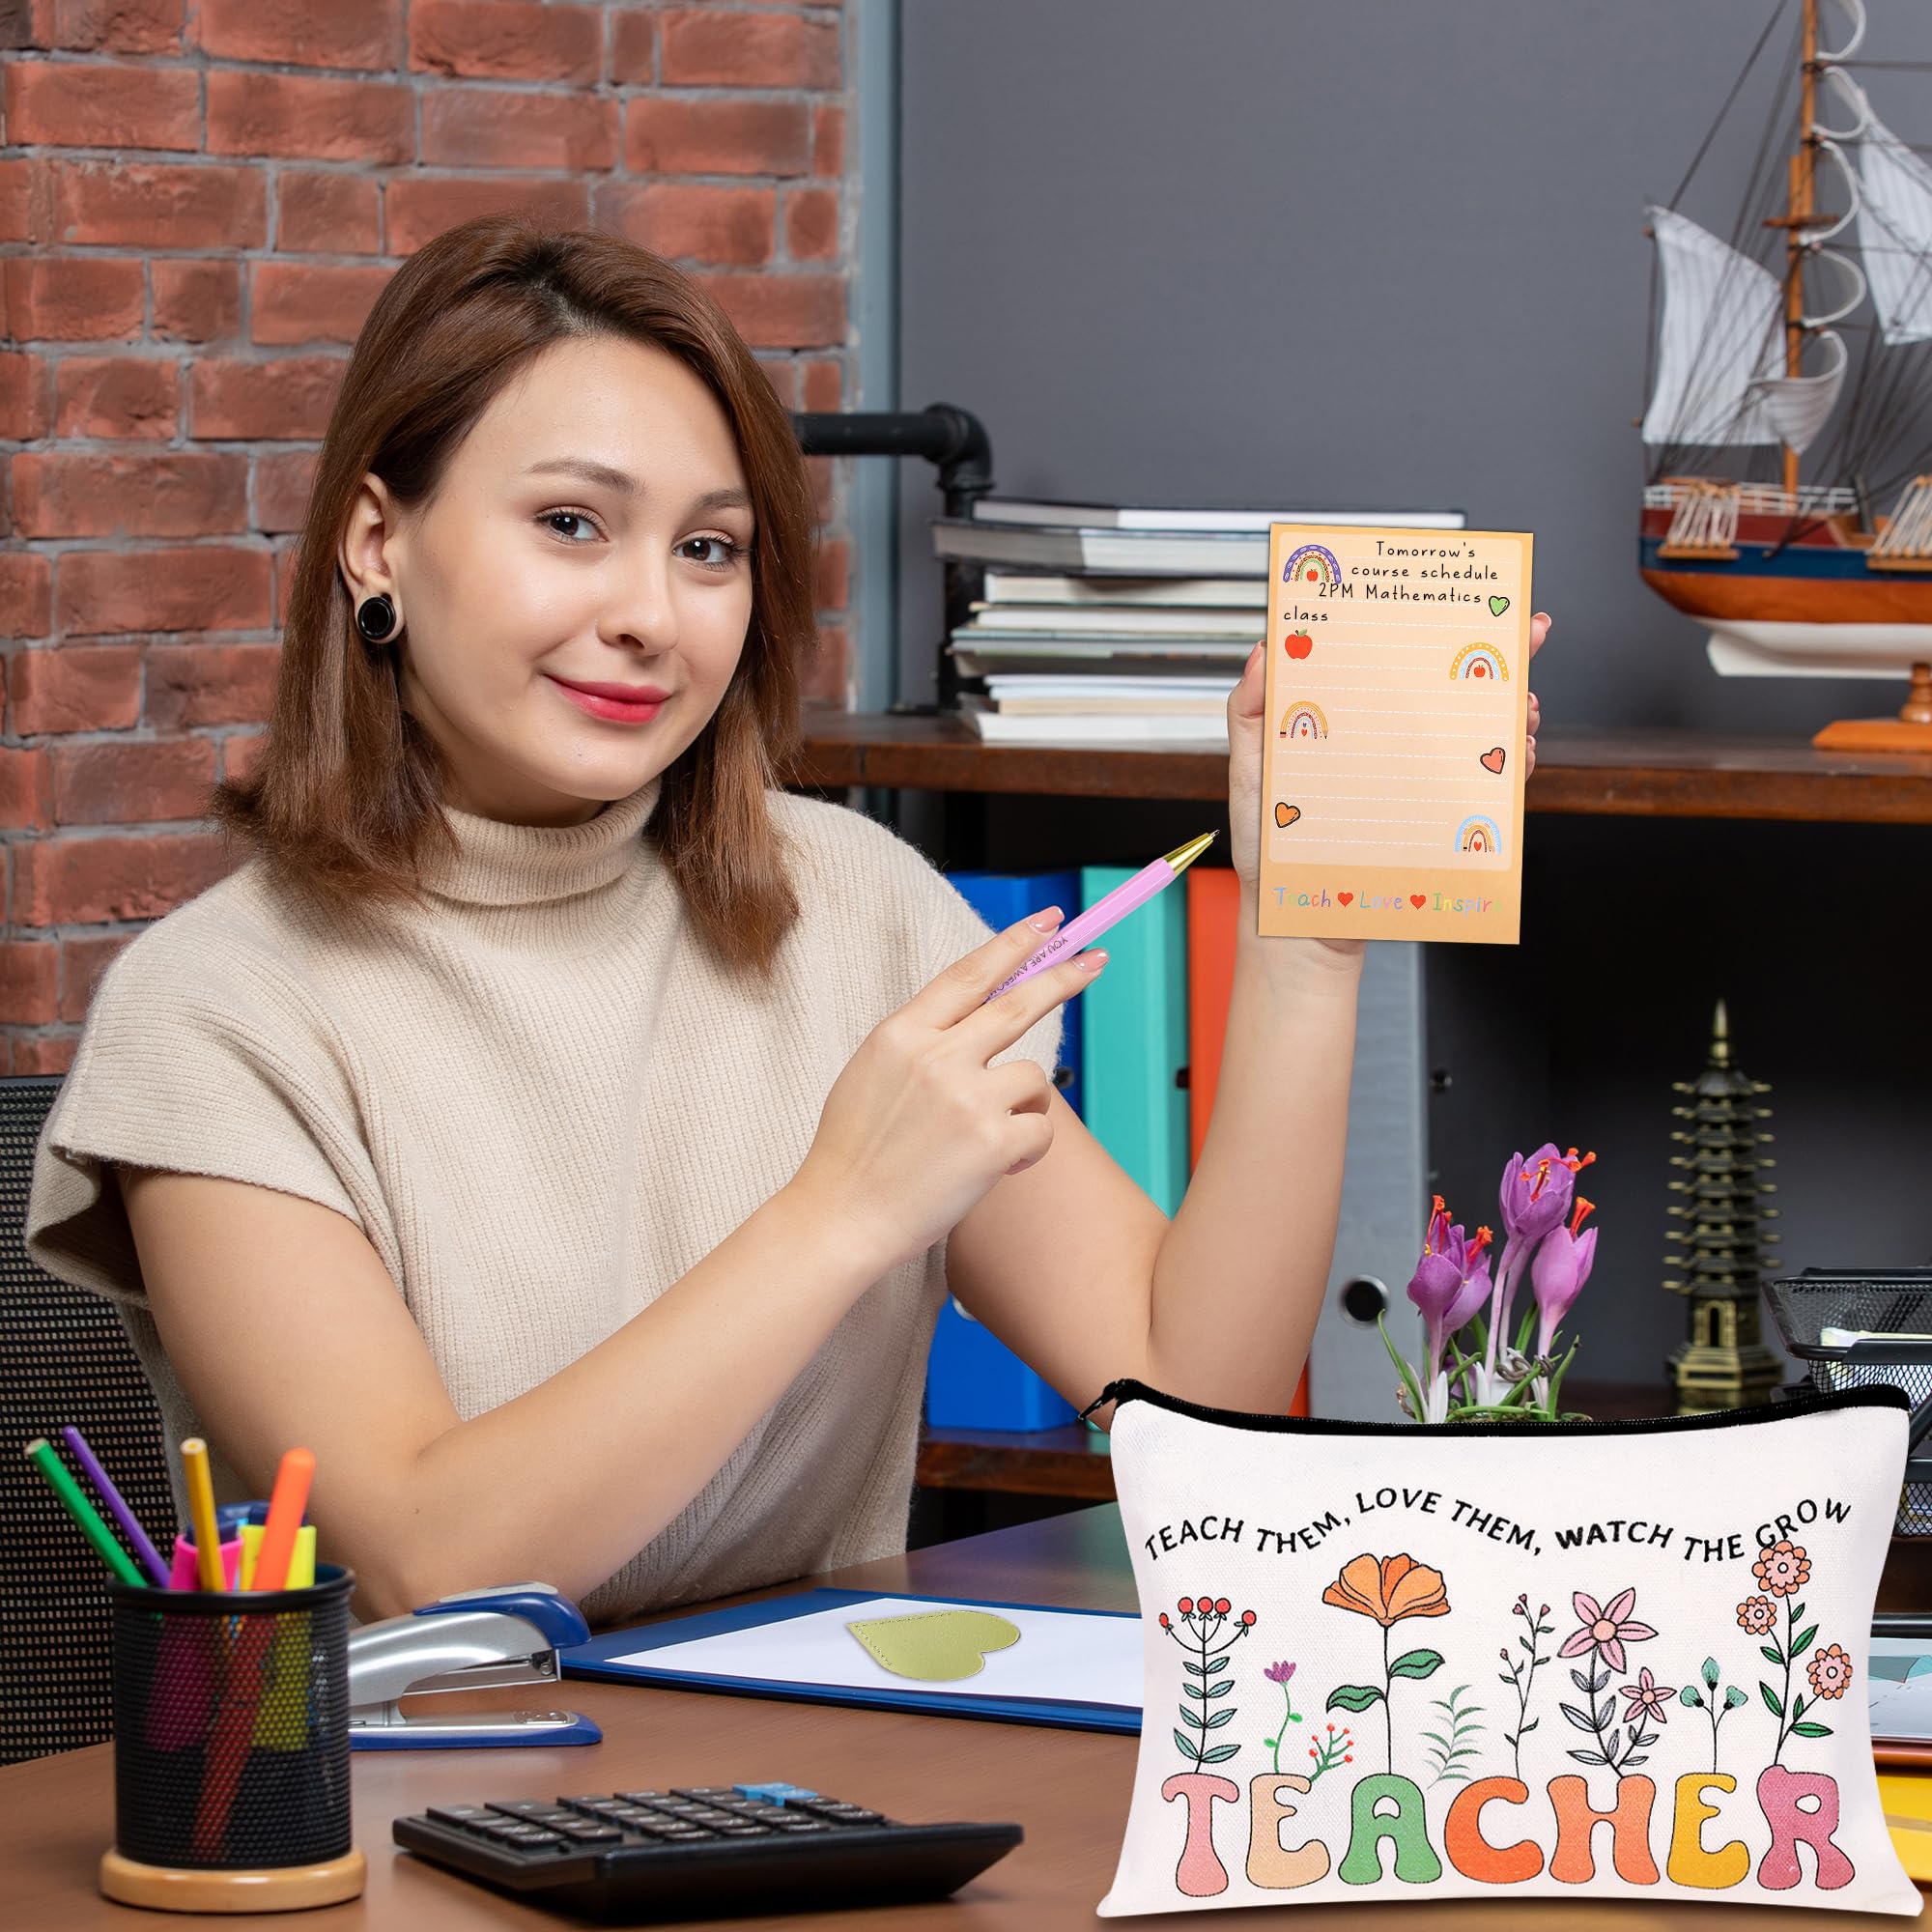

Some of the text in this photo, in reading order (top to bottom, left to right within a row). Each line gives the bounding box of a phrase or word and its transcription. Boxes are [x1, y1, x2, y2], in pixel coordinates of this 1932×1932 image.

[1376, 541, 1475, 557] Tomorrow's
[1351, 564, 1498, 580] course schedule
[1319, 582, 1481, 604] 2PM Mathematics
[1283, 605, 1328, 622] class
[1272, 887, 1504, 919] Teach Love Inspire
[1047, 936, 1068, 953] YOU
[1029, 950, 1046, 967] ARE
[1145, 1488, 1852, 1563] TEACH THEM, LOVE THEM, WATCH THE GROW
[1161, 1764, 1855, 1897] TEACHER
